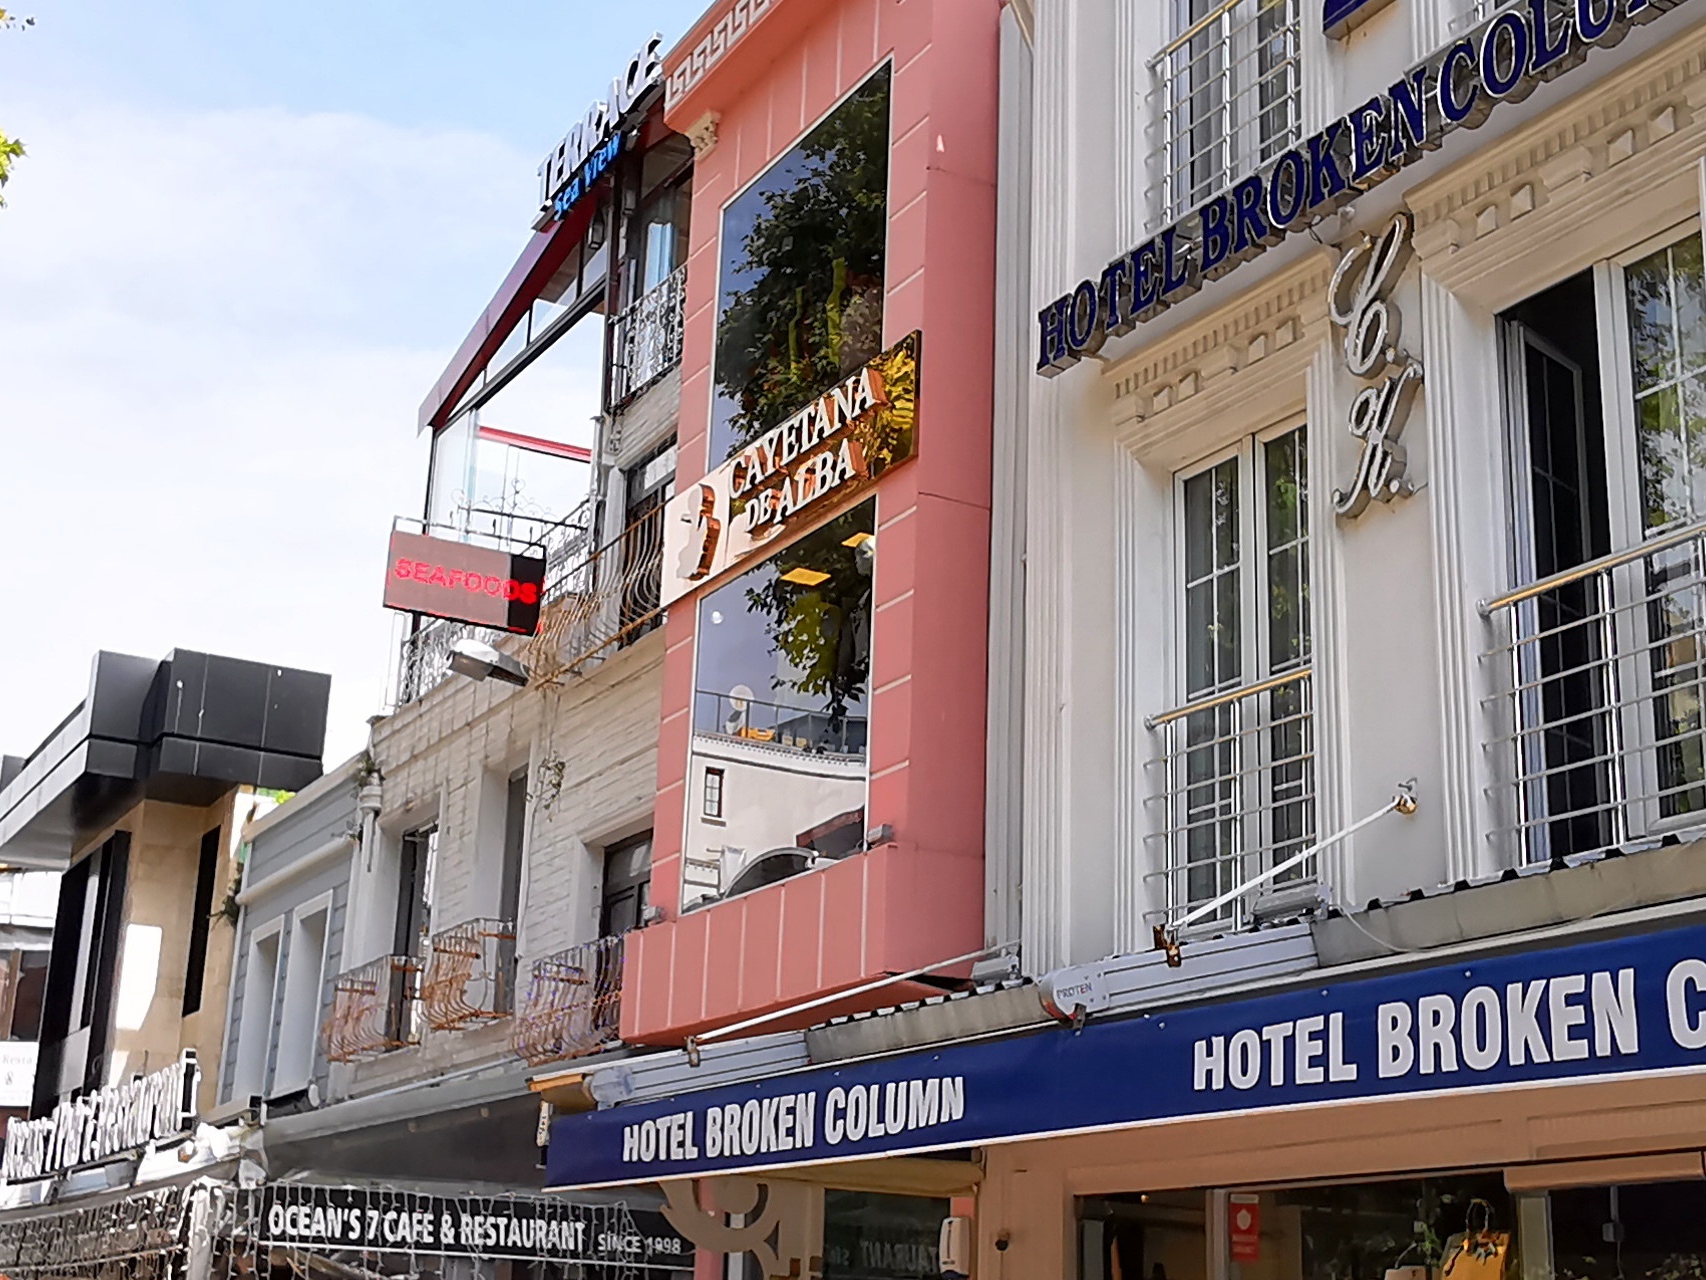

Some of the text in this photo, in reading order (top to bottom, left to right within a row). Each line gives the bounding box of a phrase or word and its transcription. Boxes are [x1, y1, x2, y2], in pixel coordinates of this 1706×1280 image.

[537, 31, 663, 208] TERRACE
[553, 132, 622, 221] Sea View
[1036, 224, 1193, 374] HOTEL
[728, 366, 877, 499] CAYETANA
[745, 437, 857, 533] DE ALBA
[394, 557, 538, 604] SEAFOODS
[1192, 1013, 1358, 1092] HOTEL
[1377, 968, 1639, 1079] BROKEN
[622, 1076, 966, 1163] HOTEL BROKEN COLUMN
[268, 1203, 361, 1241] OCEAN'S
[366, 1210, 380, 1241] 7
[383, 1210, 435, 1245] CAFE
[440, 1219, 456, 1245] &
[460, 1216, 586, 1253] RESTAURANT
